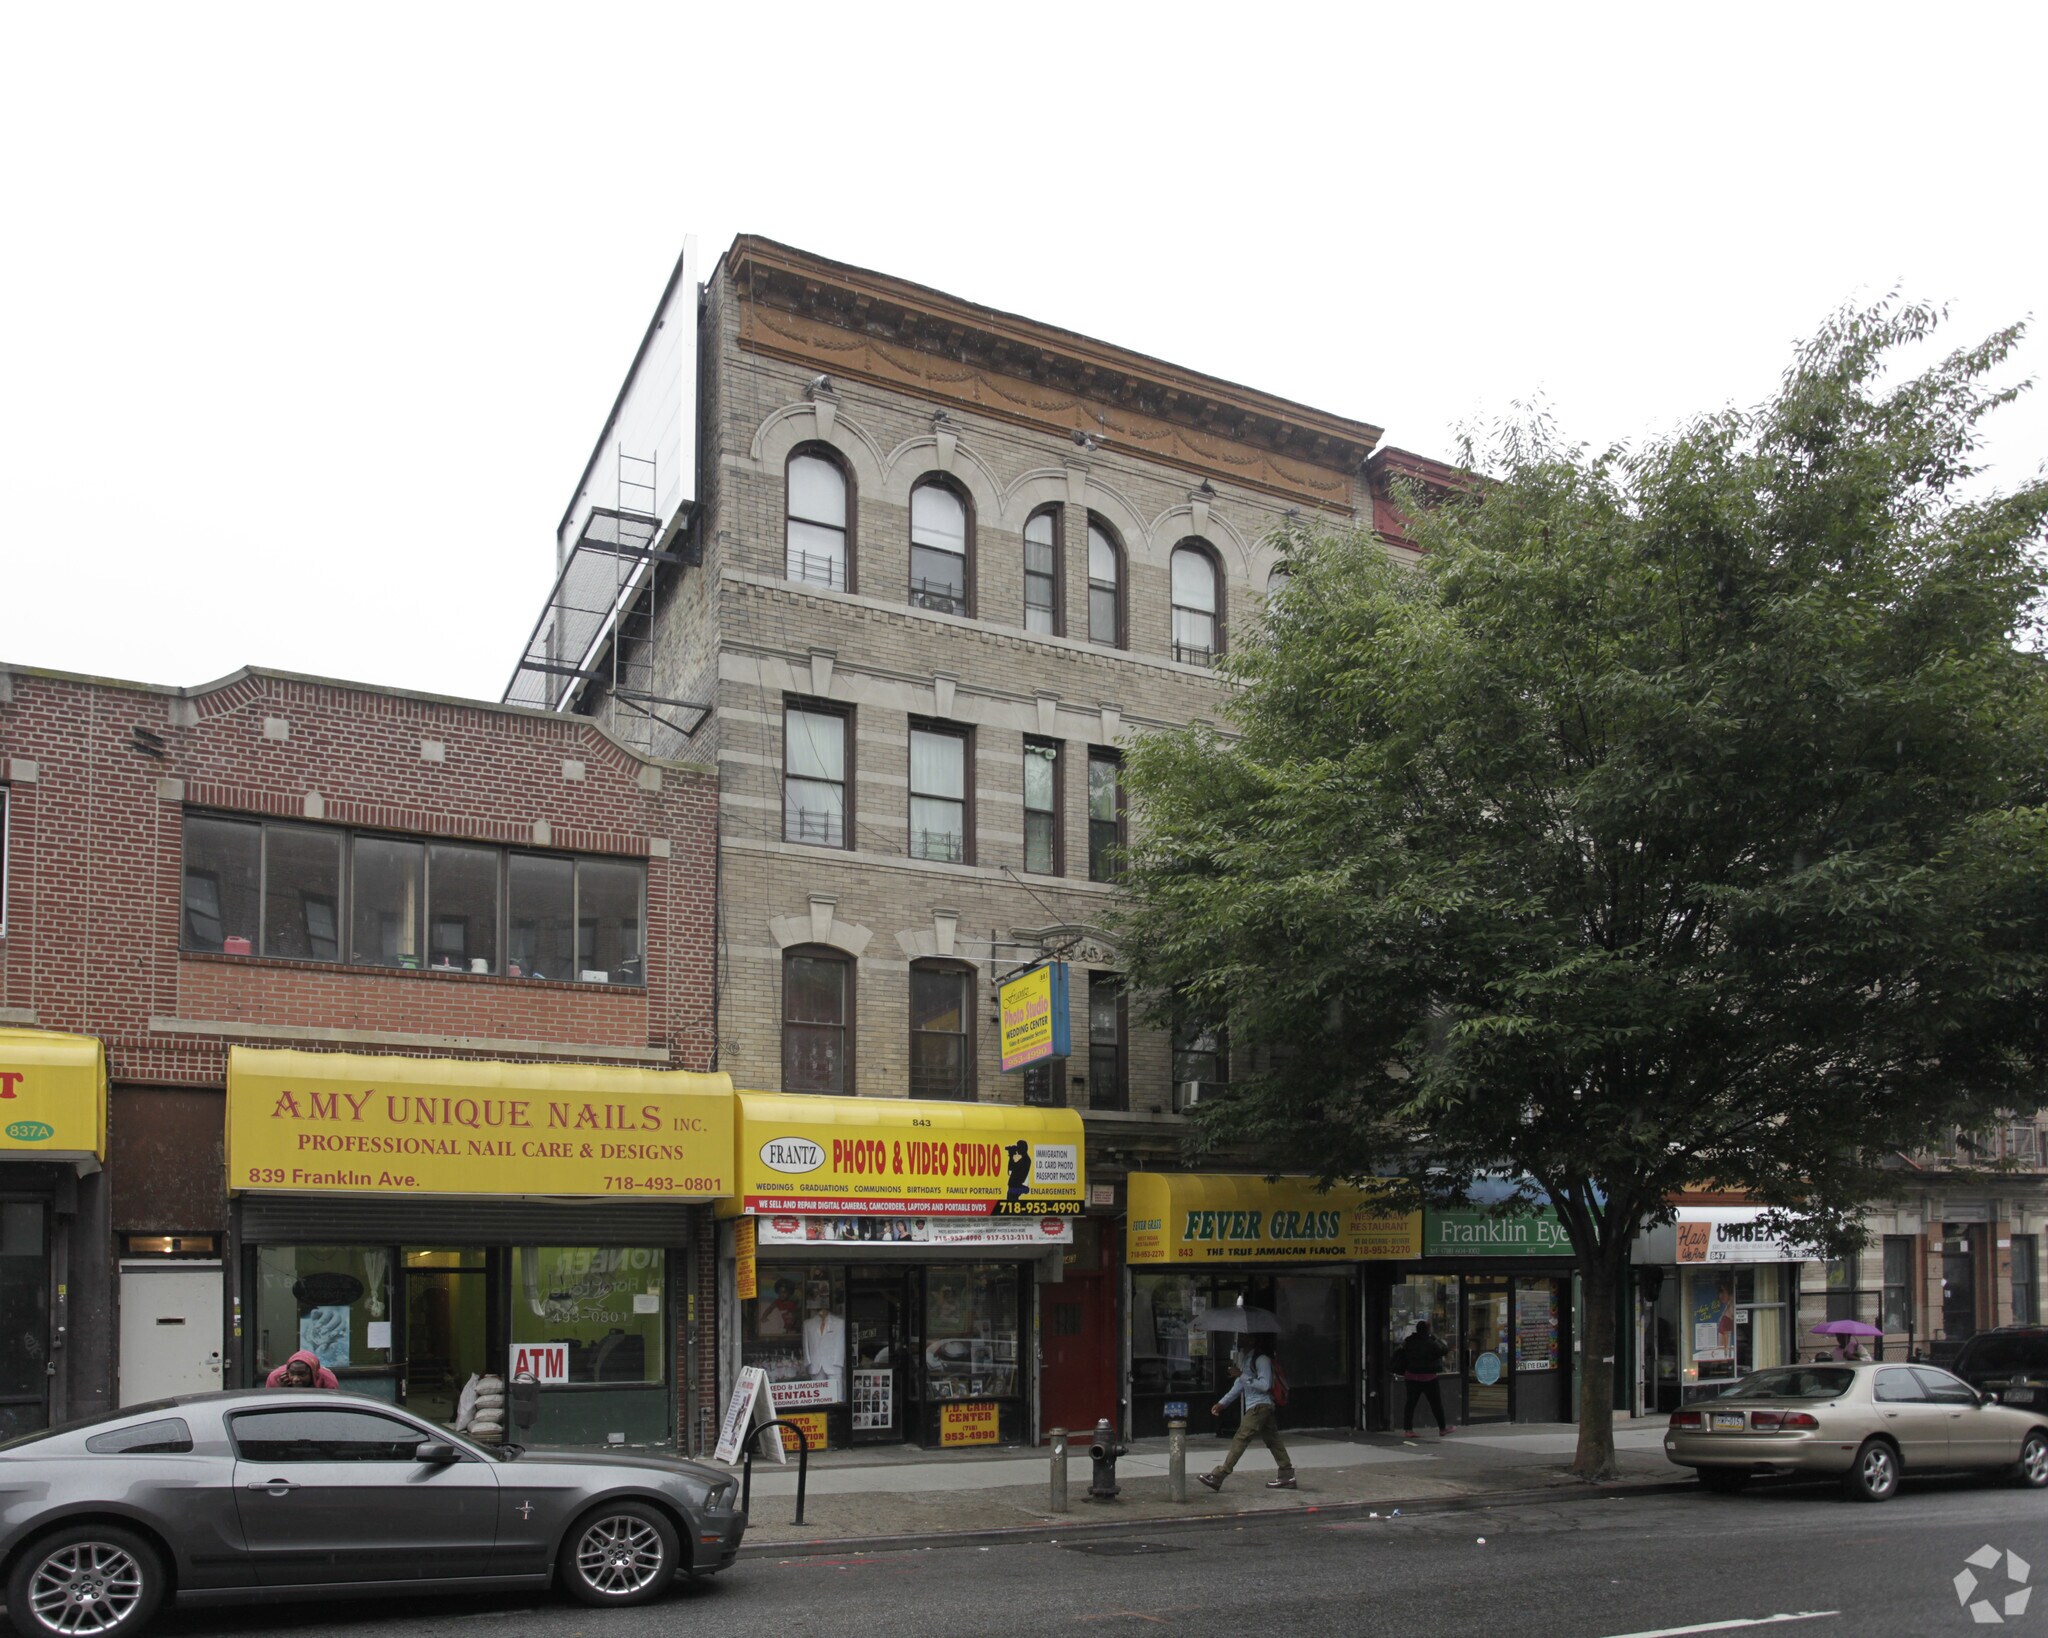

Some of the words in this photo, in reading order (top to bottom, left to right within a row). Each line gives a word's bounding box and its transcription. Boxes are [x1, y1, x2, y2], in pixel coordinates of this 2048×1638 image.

[1006, 1023, 1029, 1040] WEDDING
[1030, 1015, 1048, 1031] CENTER
[271, 1089, 376, 1121] AMY
[386, 1095, 533, 1129] UNIQUE
[548, 1102, 662, 1131] NAILS
[673, 1118, 708, 1132] INC.
[912, 1119, 932, 1127] 843
[10, 1125, 50, 1137] 837A
[297, 1134, 461, 1155] PROFESSIONAL
[468, 1140, 516, 1157] NAIL
[522, 1142, 573, 1158] CARE
[580, 1143, 594, 1158] &
[600, 1143, 684, 1160] DESIGNS
[769, 1145, 817, 1165] FRANTZ
[833, 1139, 886, 1175] PHOTO
[892, 1140, 904, 1175] &
[906, 1141, 949, 1176] VIDEO
[953, 1143, 1002, 1178] STUDIO
[1036, 1150, 1068, 1159] IMMIGRATION
[1045, 1161, 1057, 1169] CARD
[1057, 1161, 1074, 1170] PHOTO
[248, 1168, 285, 1184] 839
[292, 1169, 371, 1185] Franklin
[378, 1171, 421, 1187] Ave.
[1036, 1172, 1058, 1181] PASSPORT
[1059, 1172, 1076, 1181] PHOTO
[603, 1176, 722, 1192] 718-493-0801
[756, 1183, 795, 1191] WEDDINGS
[800, 1184, 849, 1193] GRADUATIONS
[854, 1185, 902, 1194] COMMUNIONS
[907, 1186, 942, 1194] BIRTHDAYS
[946, 1187, 968, 1195] FAMILY
[969, 1187, 1002, 1196] PORTRAITS
[1030, 1188, 1077, 1196] ENLARGEMENTS
[759, 1199, 768, 1209] WE
[769, 1200, 782, 1209] SELL
[783, 1200, 797, 1209] AND
[798, 1201, 817, 1210] REPAIR
[818, 1201, 840, 1210] DIGITAL
[841, 1202, 868, 1212] CAMERAS,
[870, 1202, 906, 1212] CAMCORDERS,
[907, 1202, 931, 1211] LAPTOPS
[931, 1203, 944, 1211] AND
[945, 1203, 971, 1211] PORTABLE
[1000, 1202, 1080, 1215] 718-953-4990
[1132, 1220, 1147, 1231] FEVER
[1148, 1219, 1161, 1230] GRASS
[1182, 1210, 1262, 1242] FEVER
[1269, 1210, 1340, 1241] GRASS
[1350, 1222, 1409, 1232] RESTAURANT
[1441, 1219, 1528, 1242] Franklin
[1678, 1224, 1708, 1247] Hair
[1130, 1250, 1165, 1258] 718-953-2270
[1178, 1248, 1193, 1257] 843
[1206, 1248, 1225, 1256] THE
[1228, 1248, 1253, 1256] TRUE
[1254, 1247, 1307, 1256] JAMAICAN
[1309, 1246, 1346, 1255] FLAVOR
[1354, 1245, 1410, 1255] 718-953-2270
[1710, 1250, 1726, 1260] 847
[514, 1348, 564, 1378] ATM
[794, 1381, 829, 1389] LIMOUSINE
[771, 1390, 820, 1400] RENTALS
[966, 1402, 995, 1412] CARD
[948, 1412, 991, 1423] CENTER
[944, 1430, 995, 1441] 953-4990
